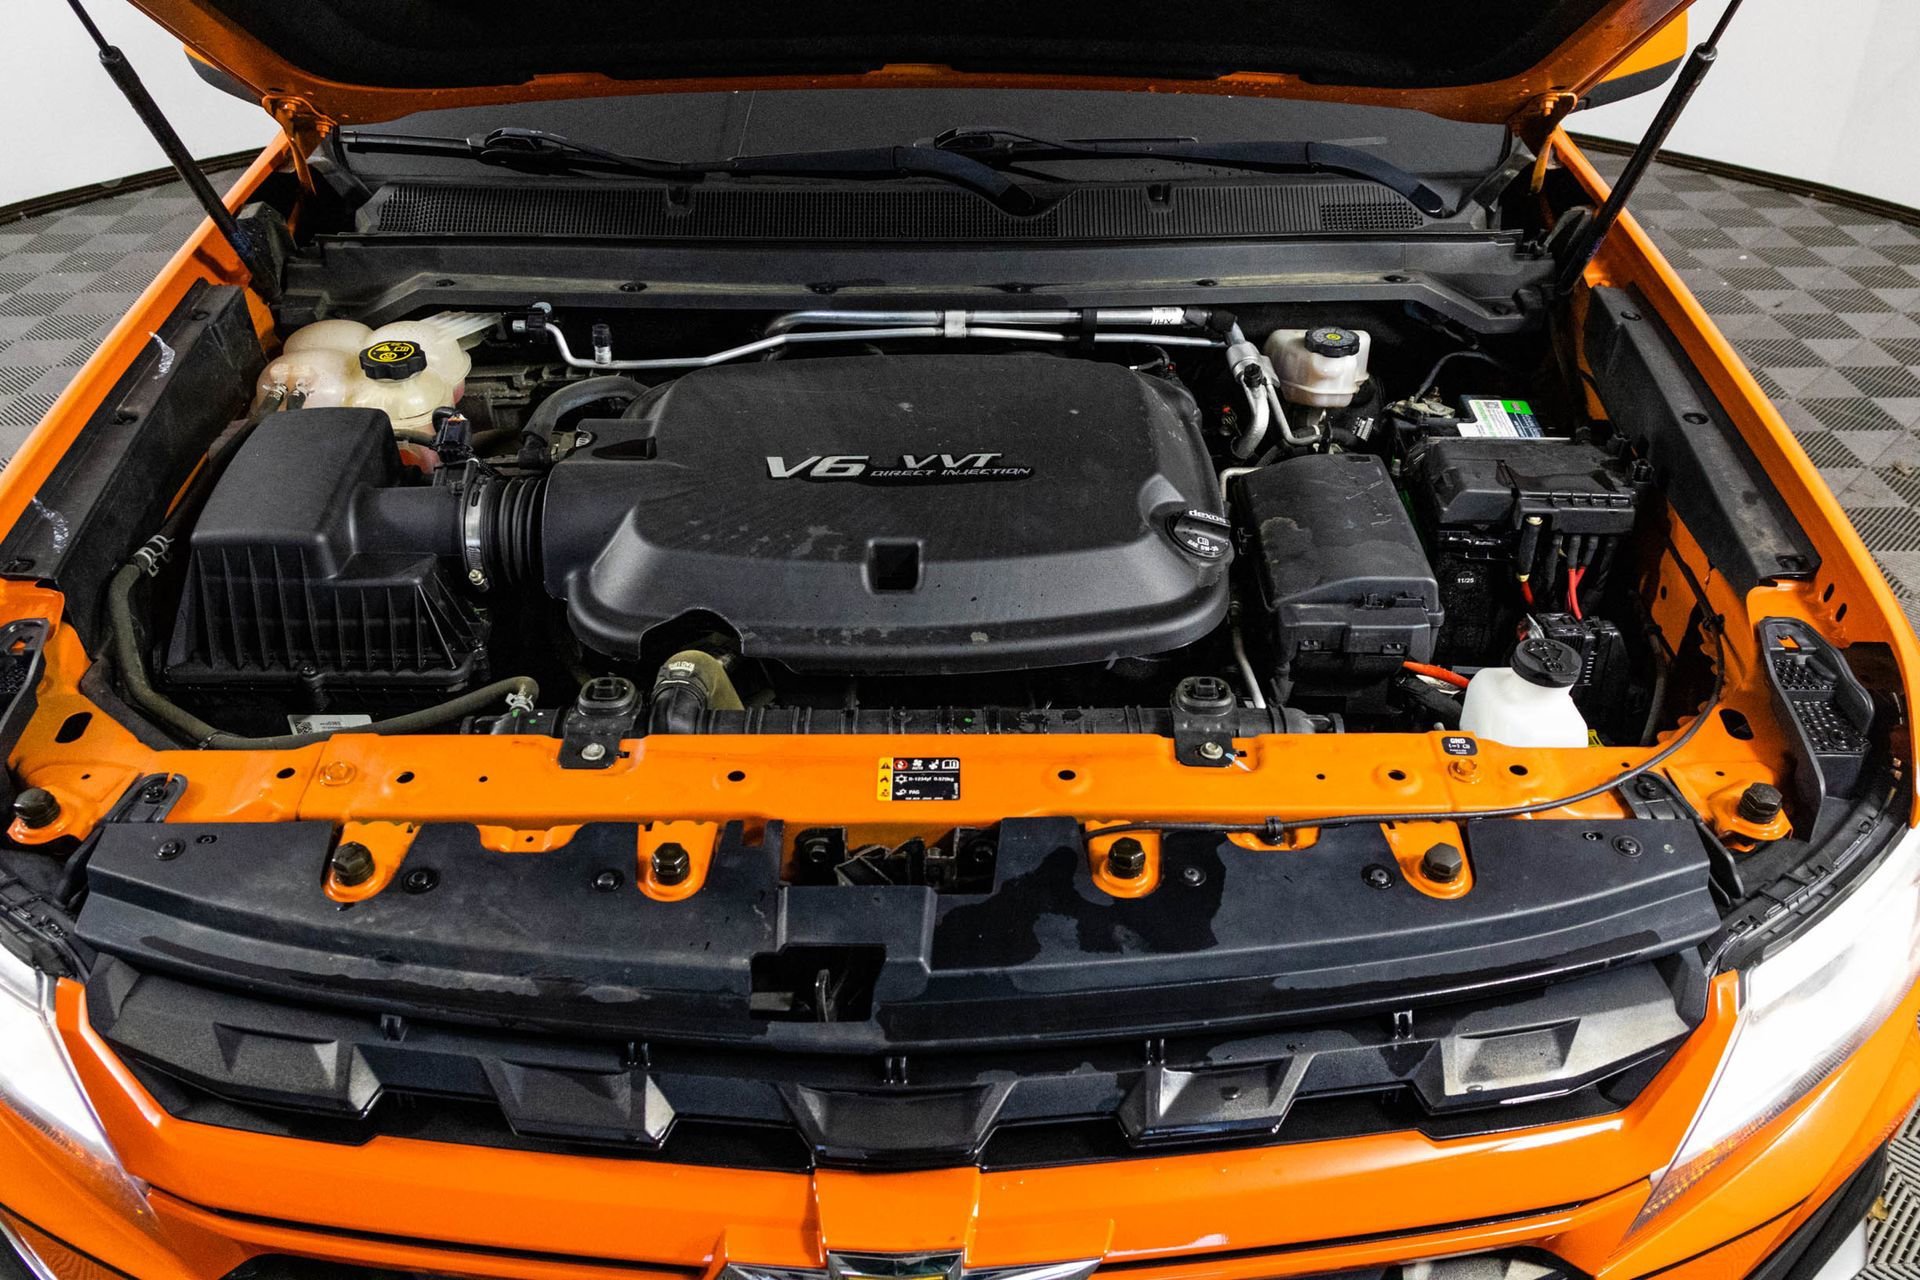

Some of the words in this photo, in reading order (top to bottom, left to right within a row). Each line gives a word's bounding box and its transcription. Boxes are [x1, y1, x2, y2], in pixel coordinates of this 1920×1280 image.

[767, 455, 869, 478] V6
[903, 452, 1002, 469] VVT
[870, 469, 936, 477] DIRECT
[941, 467, 1031, 476] INJECTION
[1188, 509, 1226, 523] dexos
